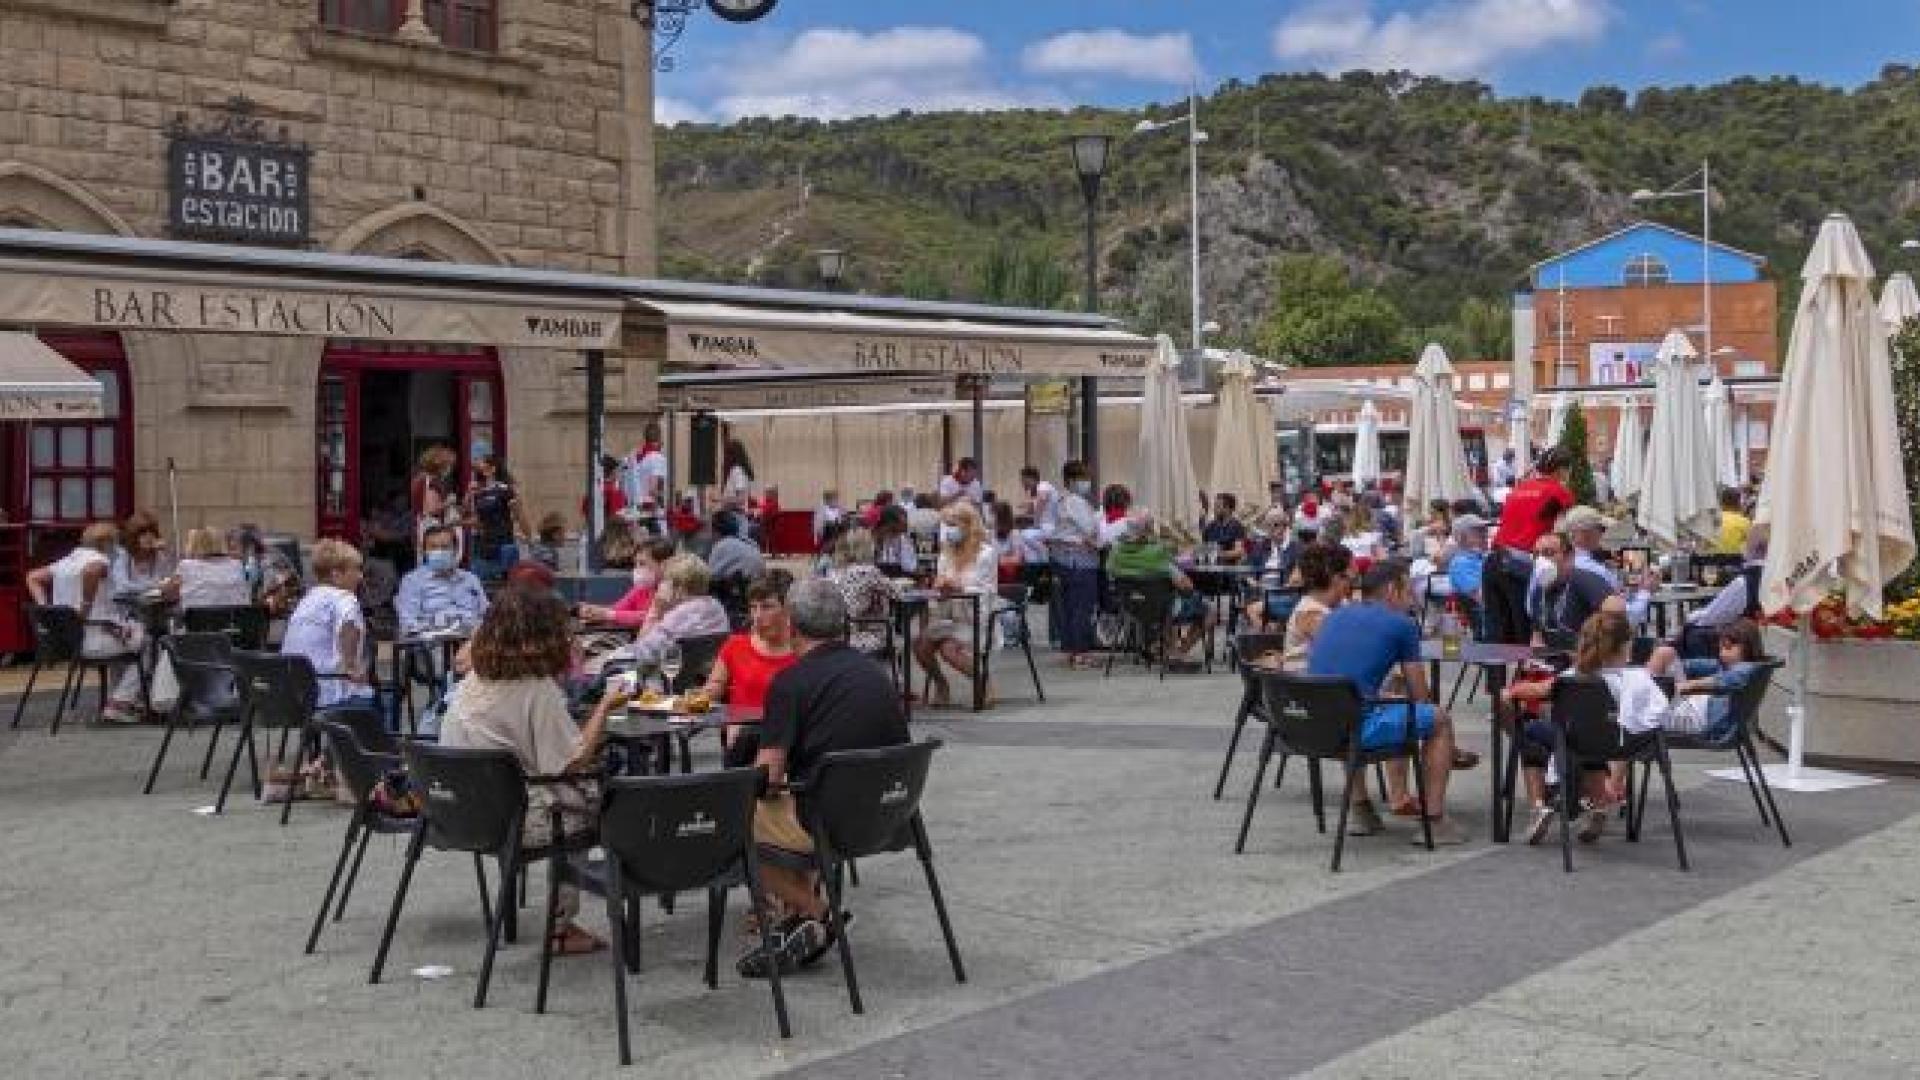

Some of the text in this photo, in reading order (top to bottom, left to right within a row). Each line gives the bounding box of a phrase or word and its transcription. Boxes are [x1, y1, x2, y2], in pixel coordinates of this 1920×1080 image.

[202, 152, 282, 197] BAR
[94, 288, 178, 325] BAR
[540, 318, 601, 338] AMBAR
[855, 342, 899, 369] BAR
